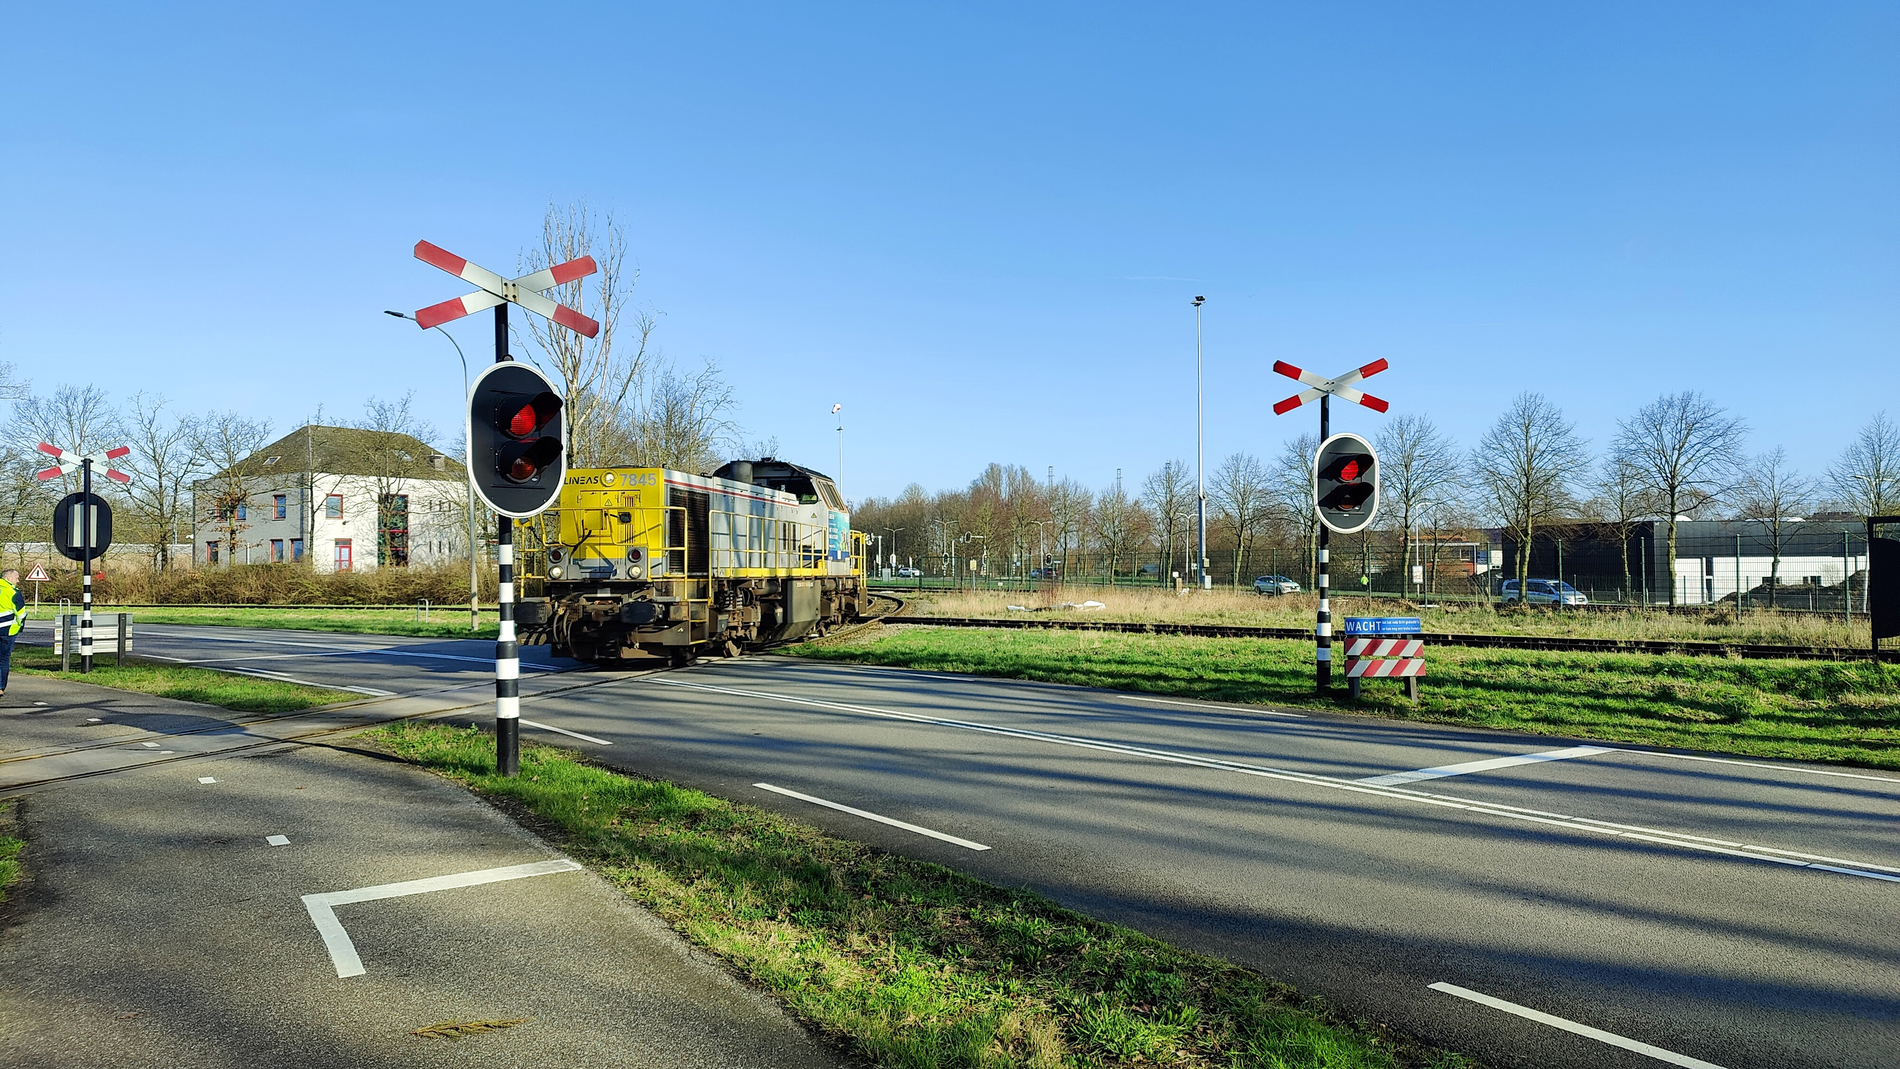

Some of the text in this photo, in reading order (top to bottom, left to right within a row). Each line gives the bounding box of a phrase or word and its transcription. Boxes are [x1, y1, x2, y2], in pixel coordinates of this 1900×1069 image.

[564, 476, 599, 485] LINEAS
[619, 473, 657, 487] 7845
[1345, 621, 1381, 632] WACHT
